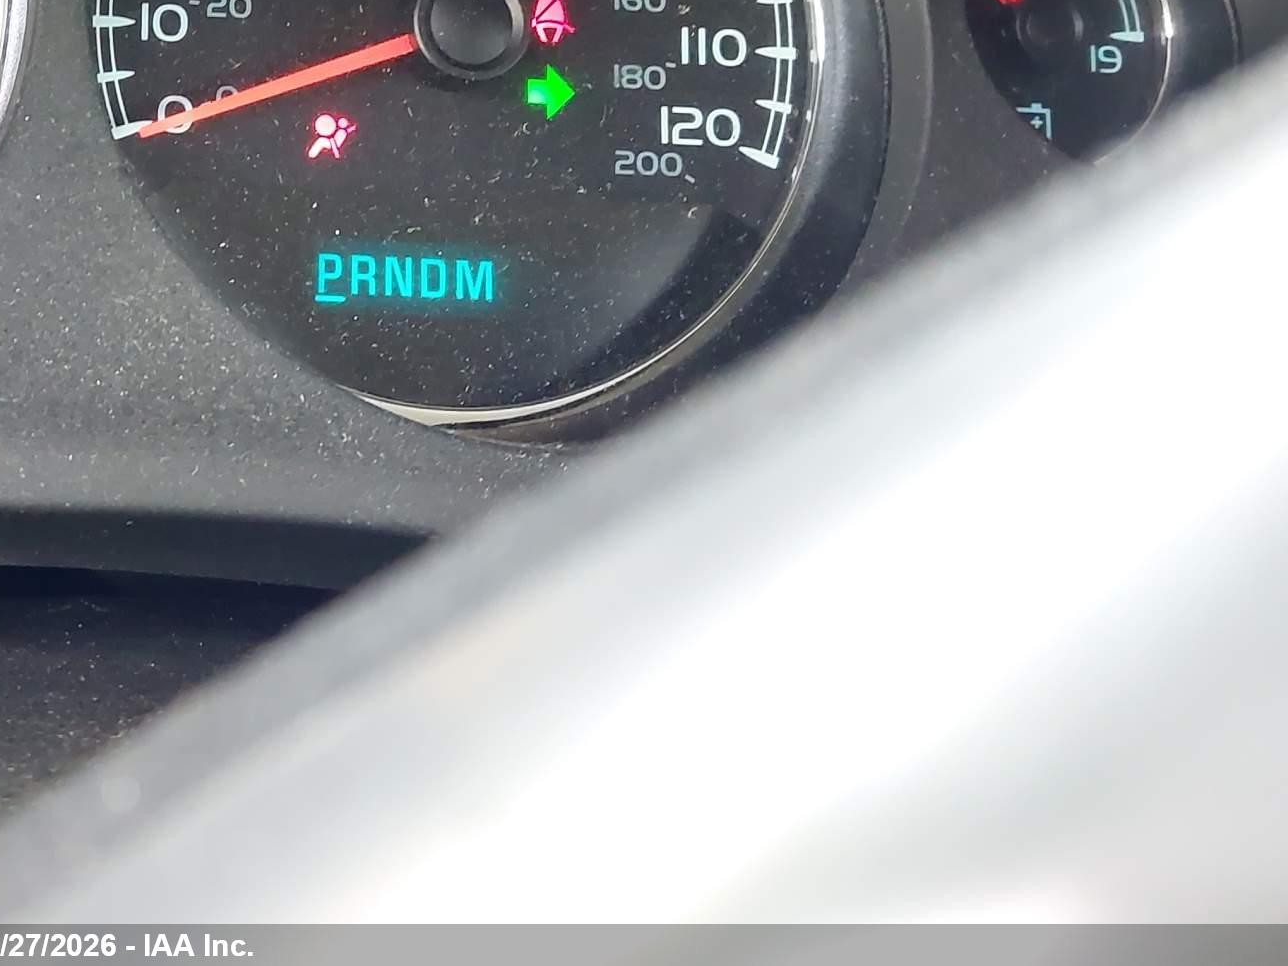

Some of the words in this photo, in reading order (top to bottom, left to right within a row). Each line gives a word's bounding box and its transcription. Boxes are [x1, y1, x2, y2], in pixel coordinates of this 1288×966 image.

[139, 2, 190, 43] 10
[680, 28, 749, 68] 110
[1090, 44, 1124, 74] 19
[613, 64, 668, 91] 180
[660, 106, 742, 147] 120
[614, 150, 684, 178] 200
[315, 252, 494, 302] PRNDM
